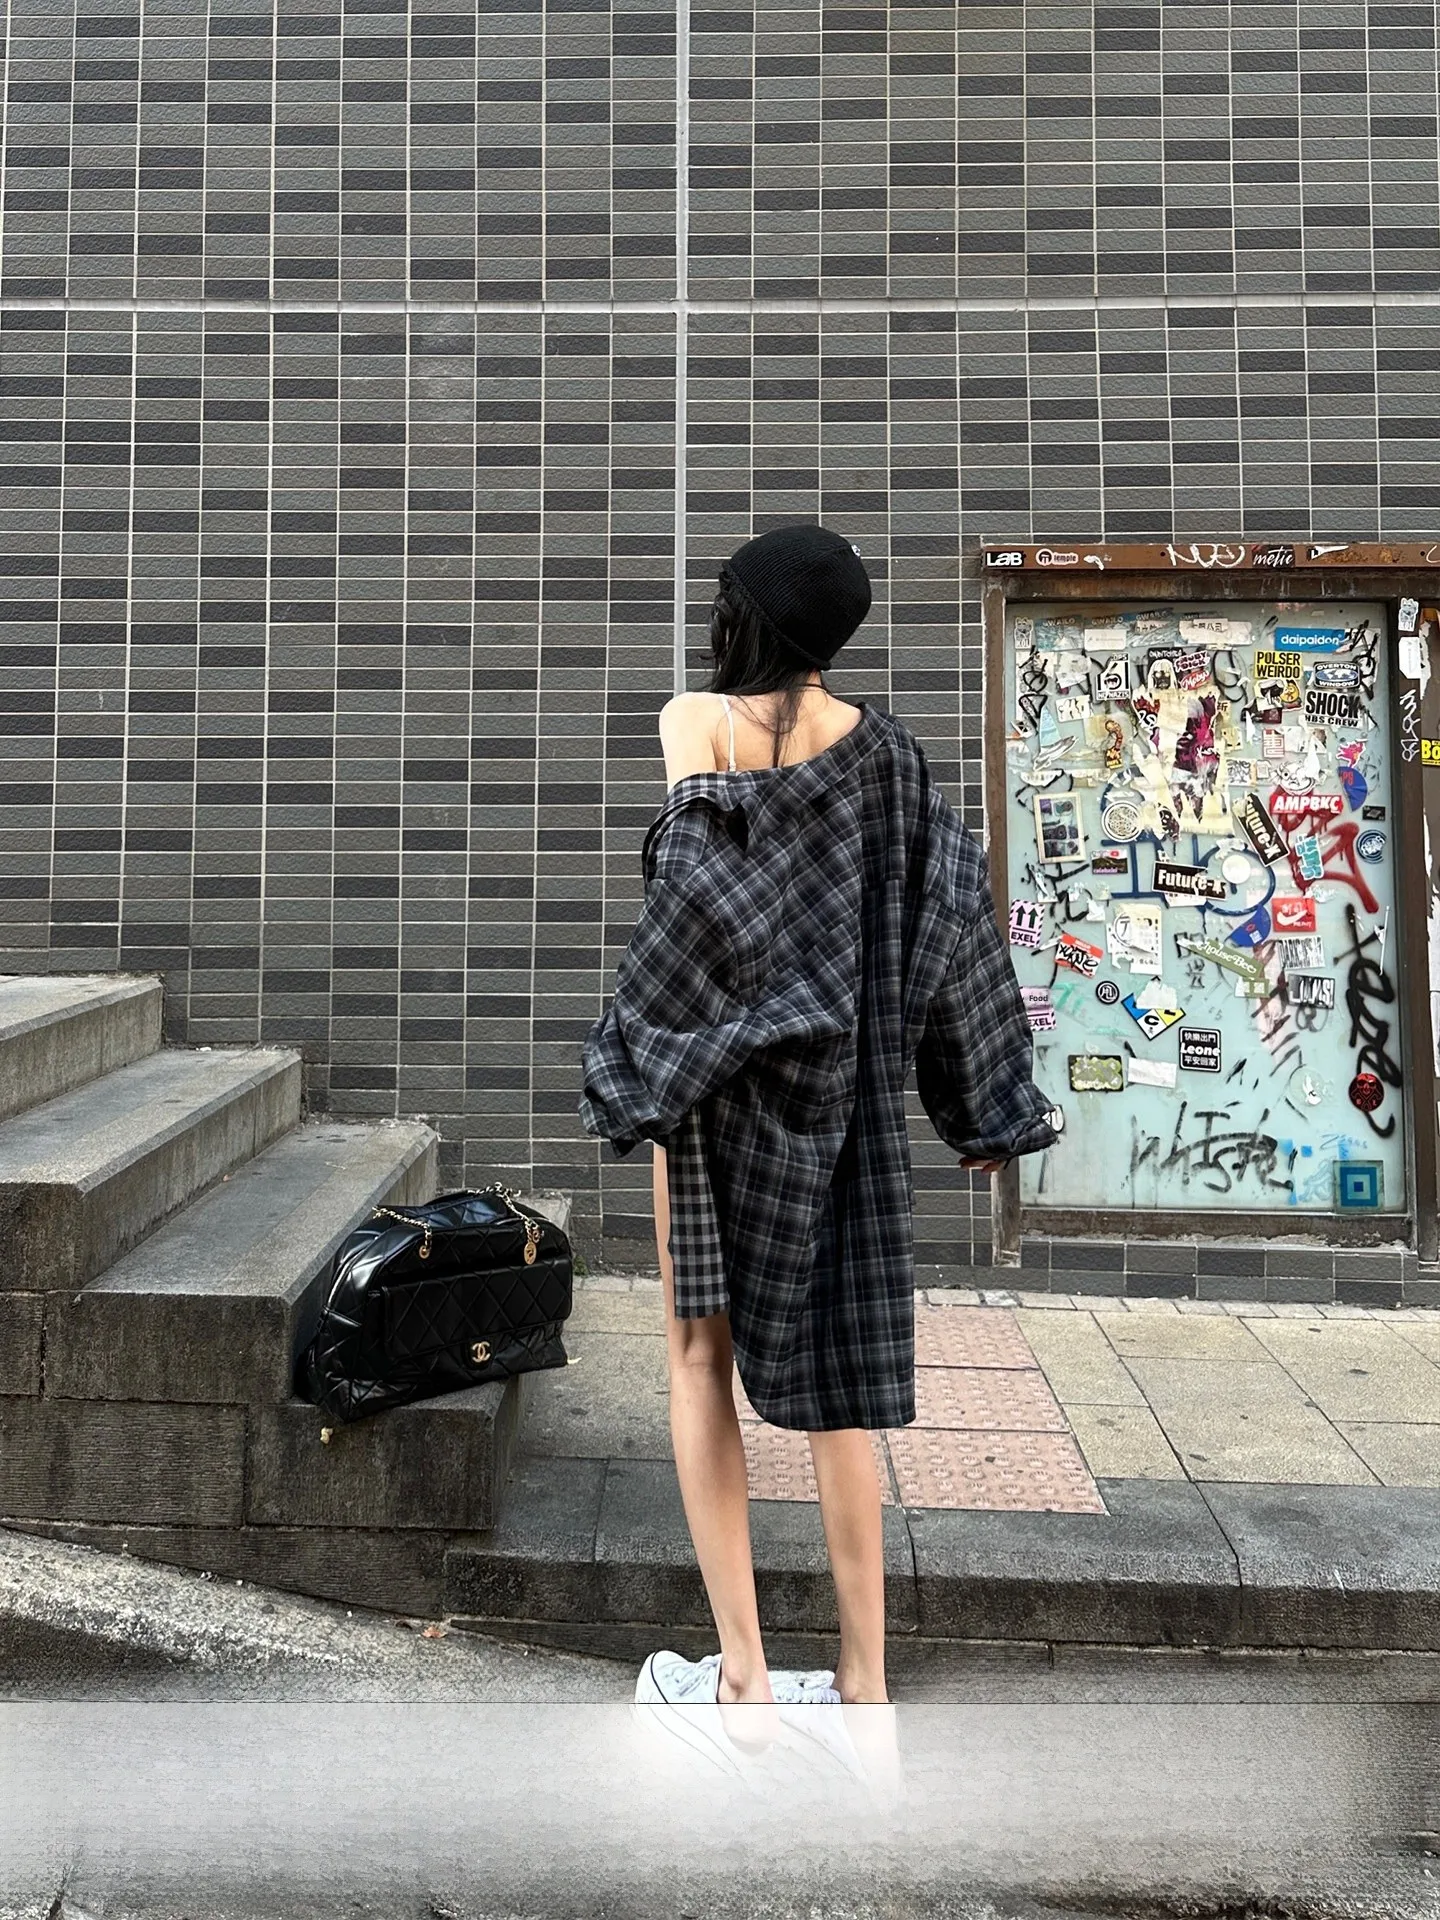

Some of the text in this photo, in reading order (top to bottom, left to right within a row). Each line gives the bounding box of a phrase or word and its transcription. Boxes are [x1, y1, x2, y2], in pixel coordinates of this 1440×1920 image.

[1257, 652, 1301, 666] POLSER
[1257, 665, 1300, 679] WEIRDO
[1306, 690, 1361, 719] SHOCK
[1327, 717, 1359, 728] CREW
[1011, 931, 1036, 943] EXEL
[1029, 994, 1049, 1002] Food
[1180, 1041, 1221, 1056] Leone
[1184, 1055, 1217, 1067] 平安回家
